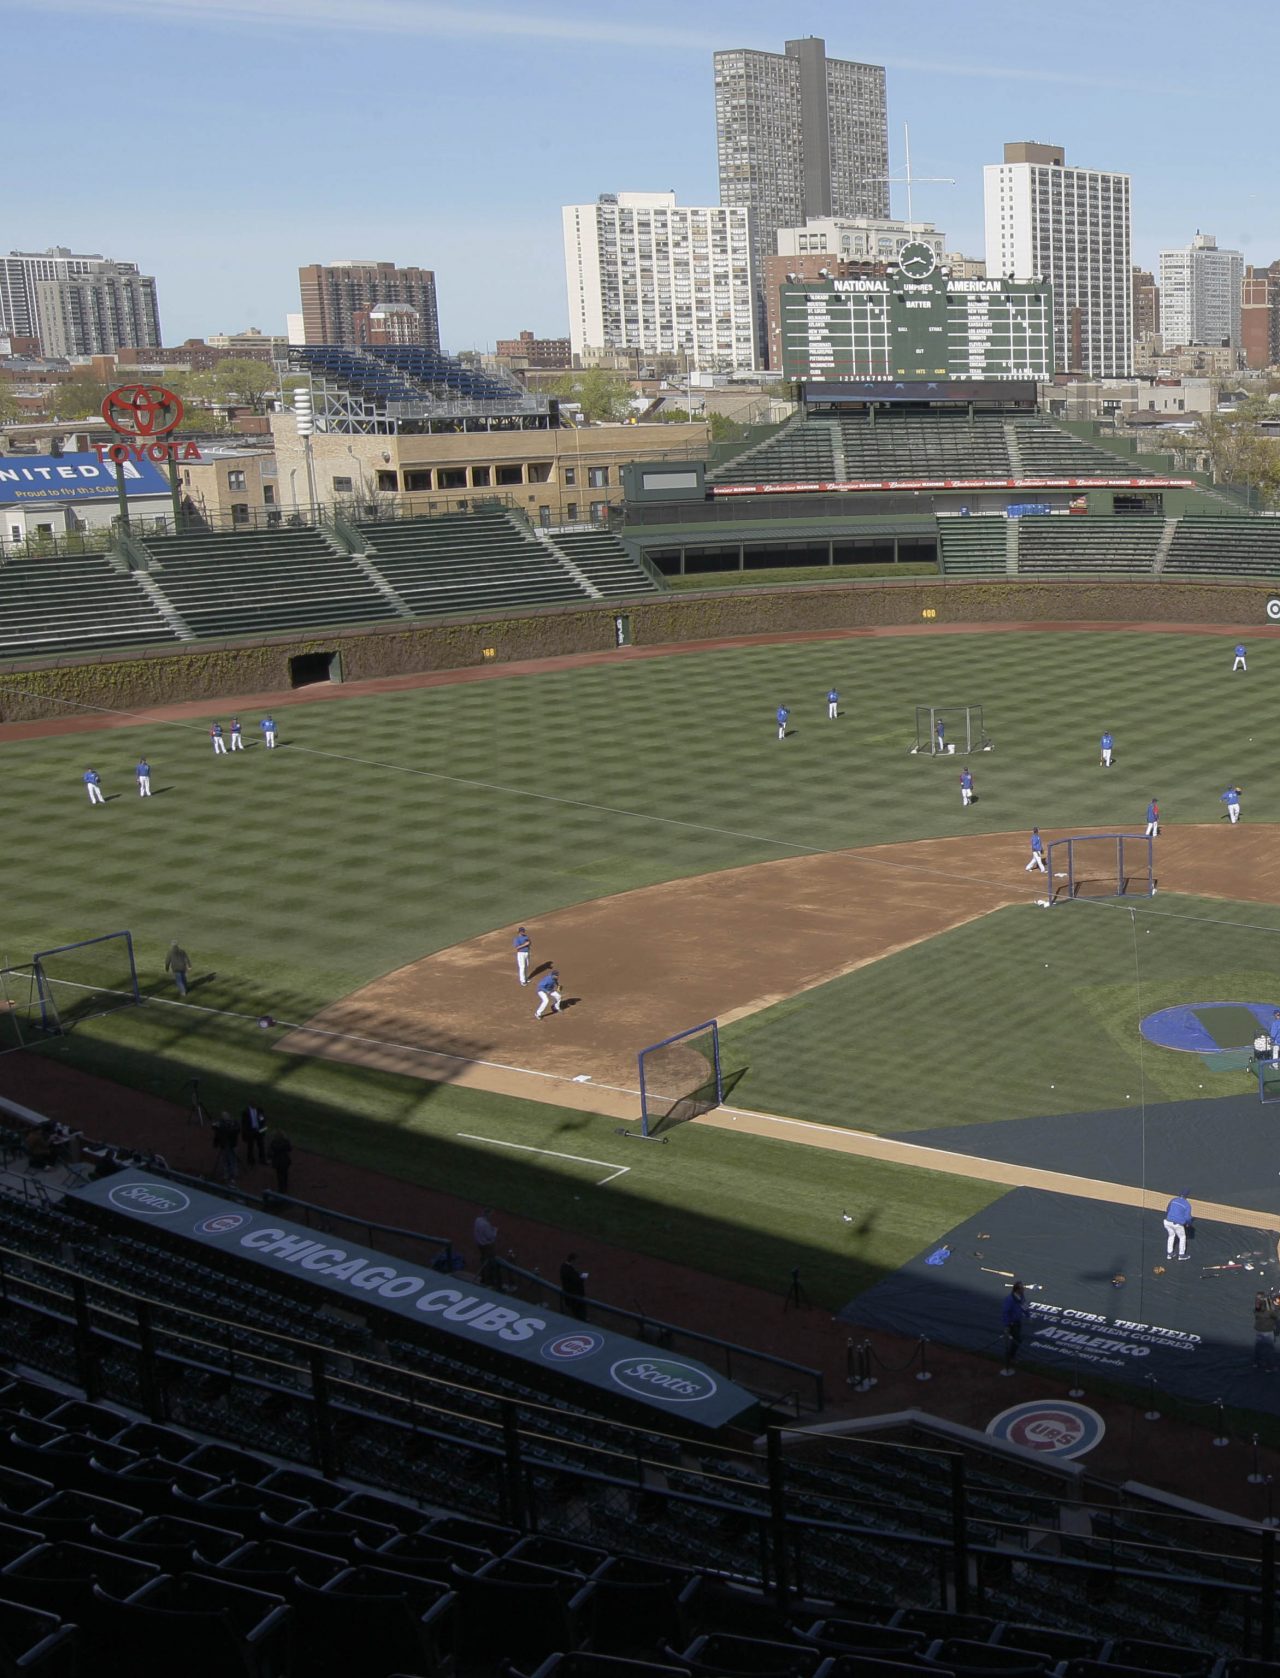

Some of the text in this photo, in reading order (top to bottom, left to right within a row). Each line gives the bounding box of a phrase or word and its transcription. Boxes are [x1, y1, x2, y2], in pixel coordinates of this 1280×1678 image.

[834, 280, 890, 291] NATIONAL
[903, 284, 933, 292] UMPIRES
[946, 281, 1001, 292] AMERICAN
[906, 300, 932, 308] BATTER
[91, 442, 202, 464] TOYOTA
[0, 465, 100, 482] NITED
[15, 489, 47, 498] Proud
[48, 488, 60, 497] to
[61, 486, 76, 497] fly
[77, 486, 95, 495] the
[763, 484, 796, 492] Budweiser
[826, 482, 858, 490] Budweiser
[922, 609, 936, 618] 400
[119, 1185, 178, 1210] Scotts
[240, 1228, 546, 1341] CHICAGO CUBS
[1029, 1301, 1203, 1344] THE CUBS. THE FIELD.
[1061, 1317, 1091, 1330] GOT
[1090, 1323, 1132, 1338] THEM
[1130, 1330, 1196, 1351] COVERED.
[1034, 1326, 1151, 1357] ATHLETICO
[624, 1363, 701, 1396] Scotts
